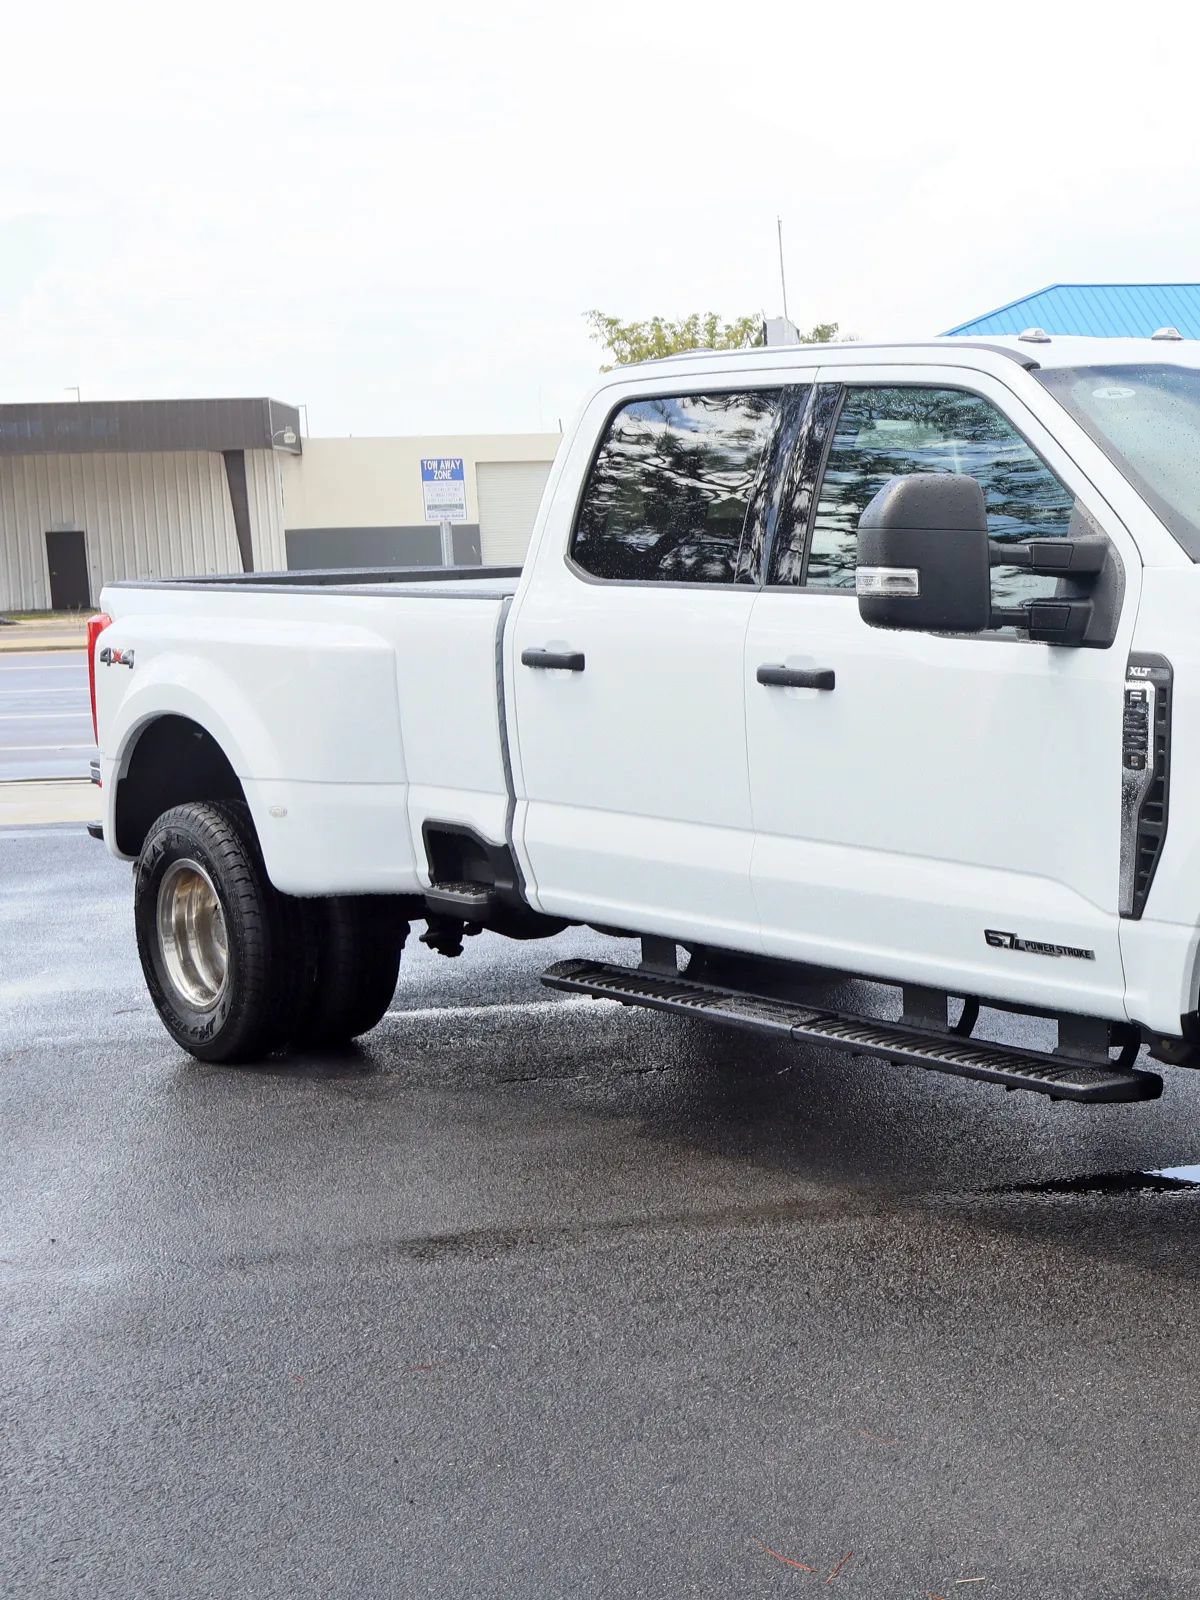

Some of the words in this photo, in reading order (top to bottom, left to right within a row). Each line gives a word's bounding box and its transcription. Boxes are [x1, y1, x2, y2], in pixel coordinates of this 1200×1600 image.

[423, 460, 438, 470] TOW
[440, 459, 461, 470] AWAY
[434, 470, 452, 480] ZONE
[1129, 666, 1152, 677] XLT
[984, 929, 1026, 953] 6.7L
[1025, 940, 1056, 953] POWER
[1056, 945, 1092, 959] STROKE
